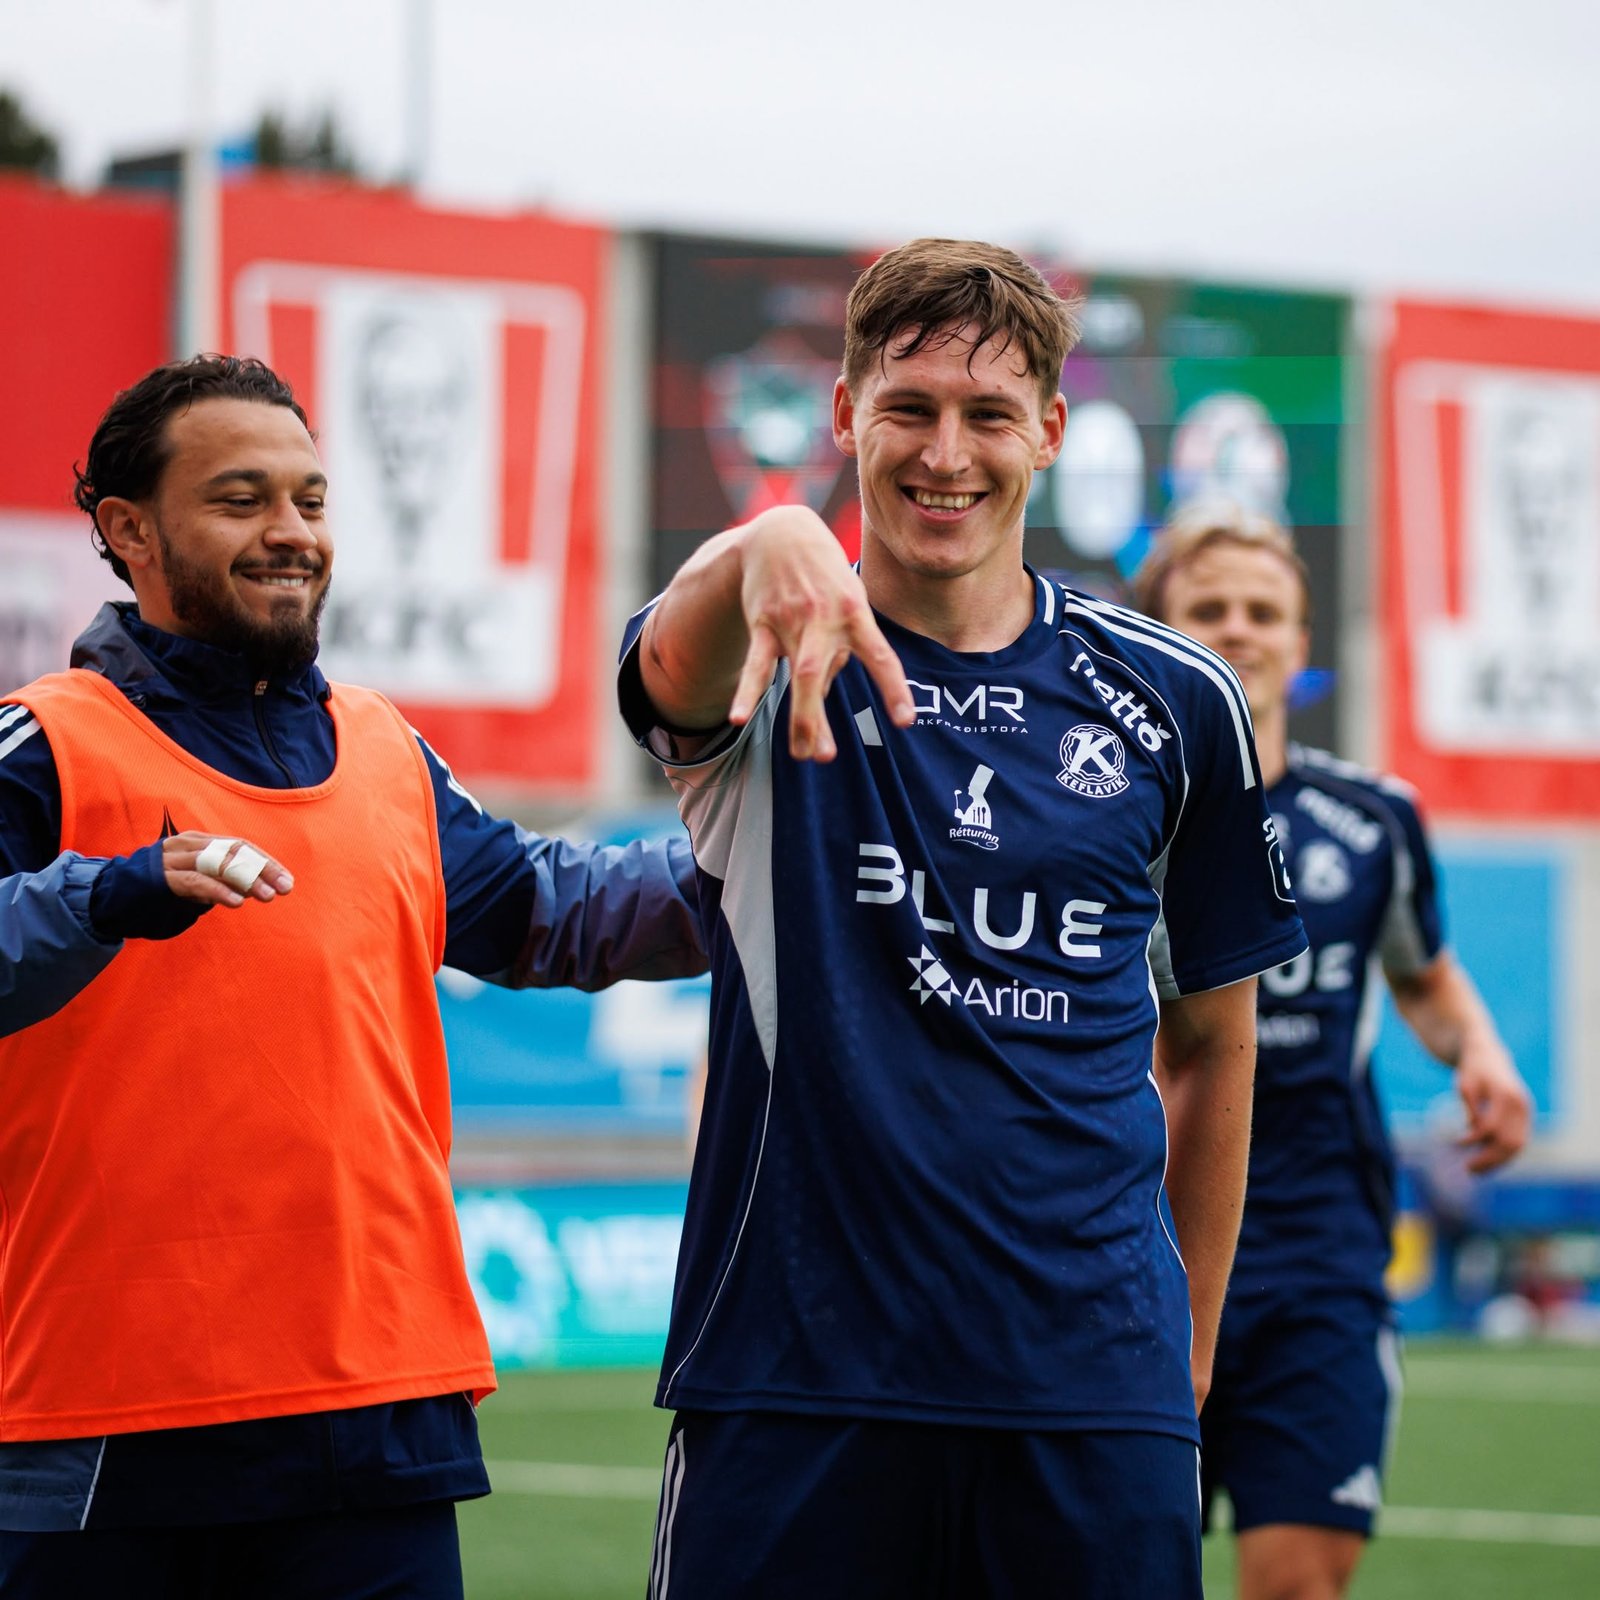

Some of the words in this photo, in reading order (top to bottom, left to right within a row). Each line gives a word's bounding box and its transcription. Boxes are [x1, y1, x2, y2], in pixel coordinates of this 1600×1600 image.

[949, 827, 1000, 843] Rétturinn
[856, 843, 1107, 958] BLUE
[1262, 941, 1355, 997] UE
[963, 978, 1069, 1023] Arion
